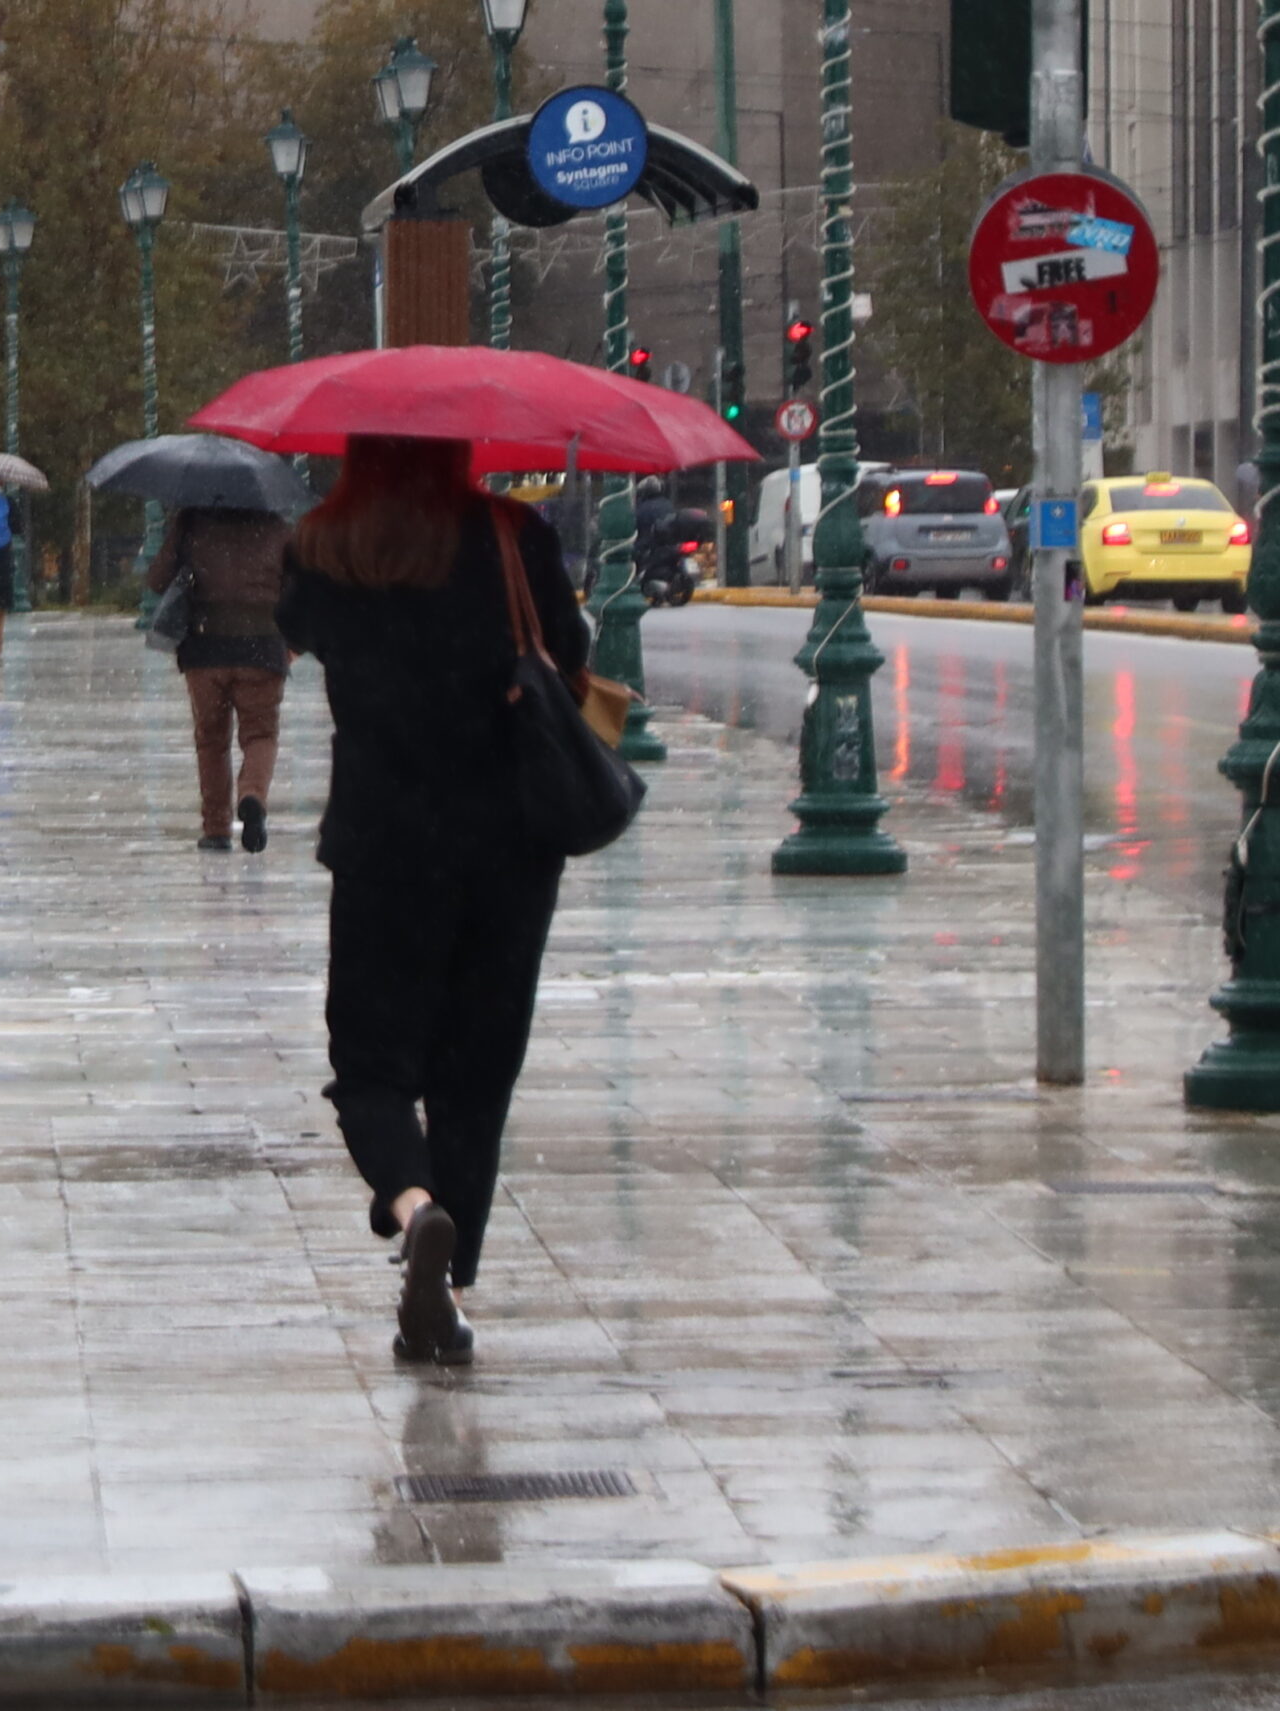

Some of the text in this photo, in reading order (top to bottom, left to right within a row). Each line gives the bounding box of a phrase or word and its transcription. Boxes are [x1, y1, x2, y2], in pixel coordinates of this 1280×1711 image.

[546, 138, 634, 167] INFO POINT
[556, 162, 628, 185] Syntagma
[574, 175, 620, 191] square
[1036, 257, 1086, 284] FREE
